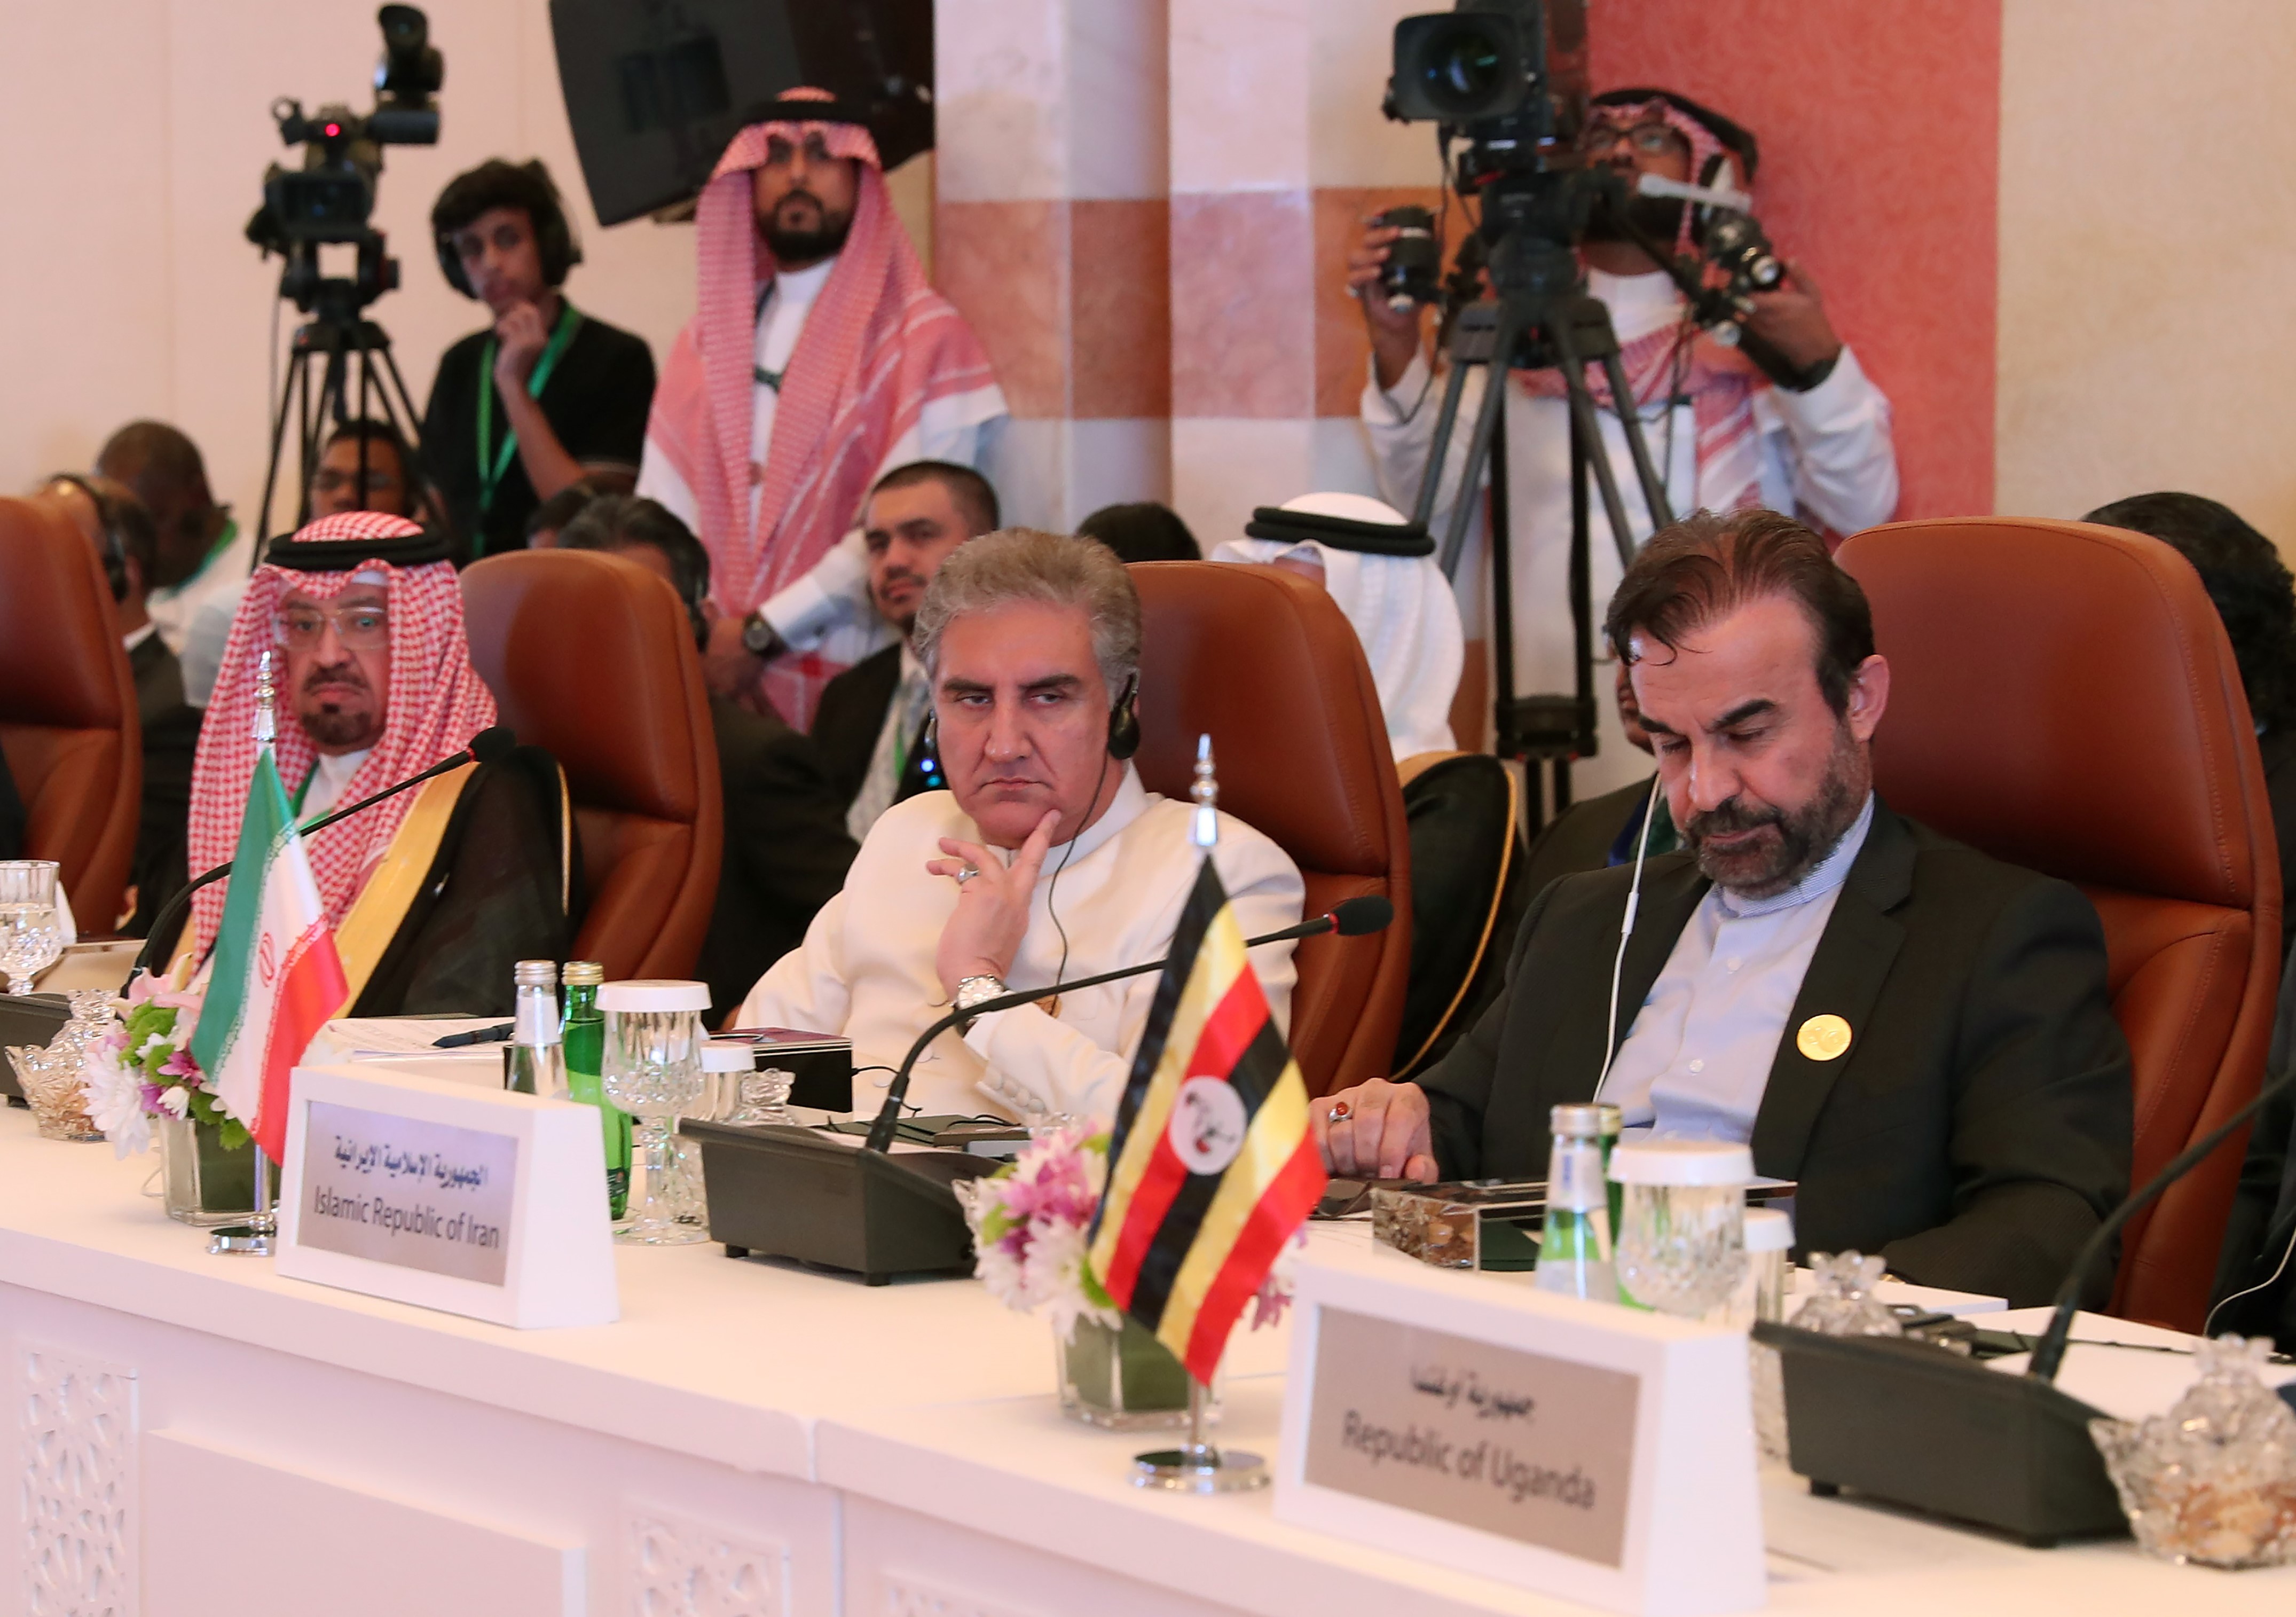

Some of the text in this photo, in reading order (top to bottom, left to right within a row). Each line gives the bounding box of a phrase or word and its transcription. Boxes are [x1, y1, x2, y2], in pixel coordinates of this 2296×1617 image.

[314, 1185, 499, 1249] Islamic Republic of Iran
[1342, 1408, 1595, 1510] Republic of Uganda
